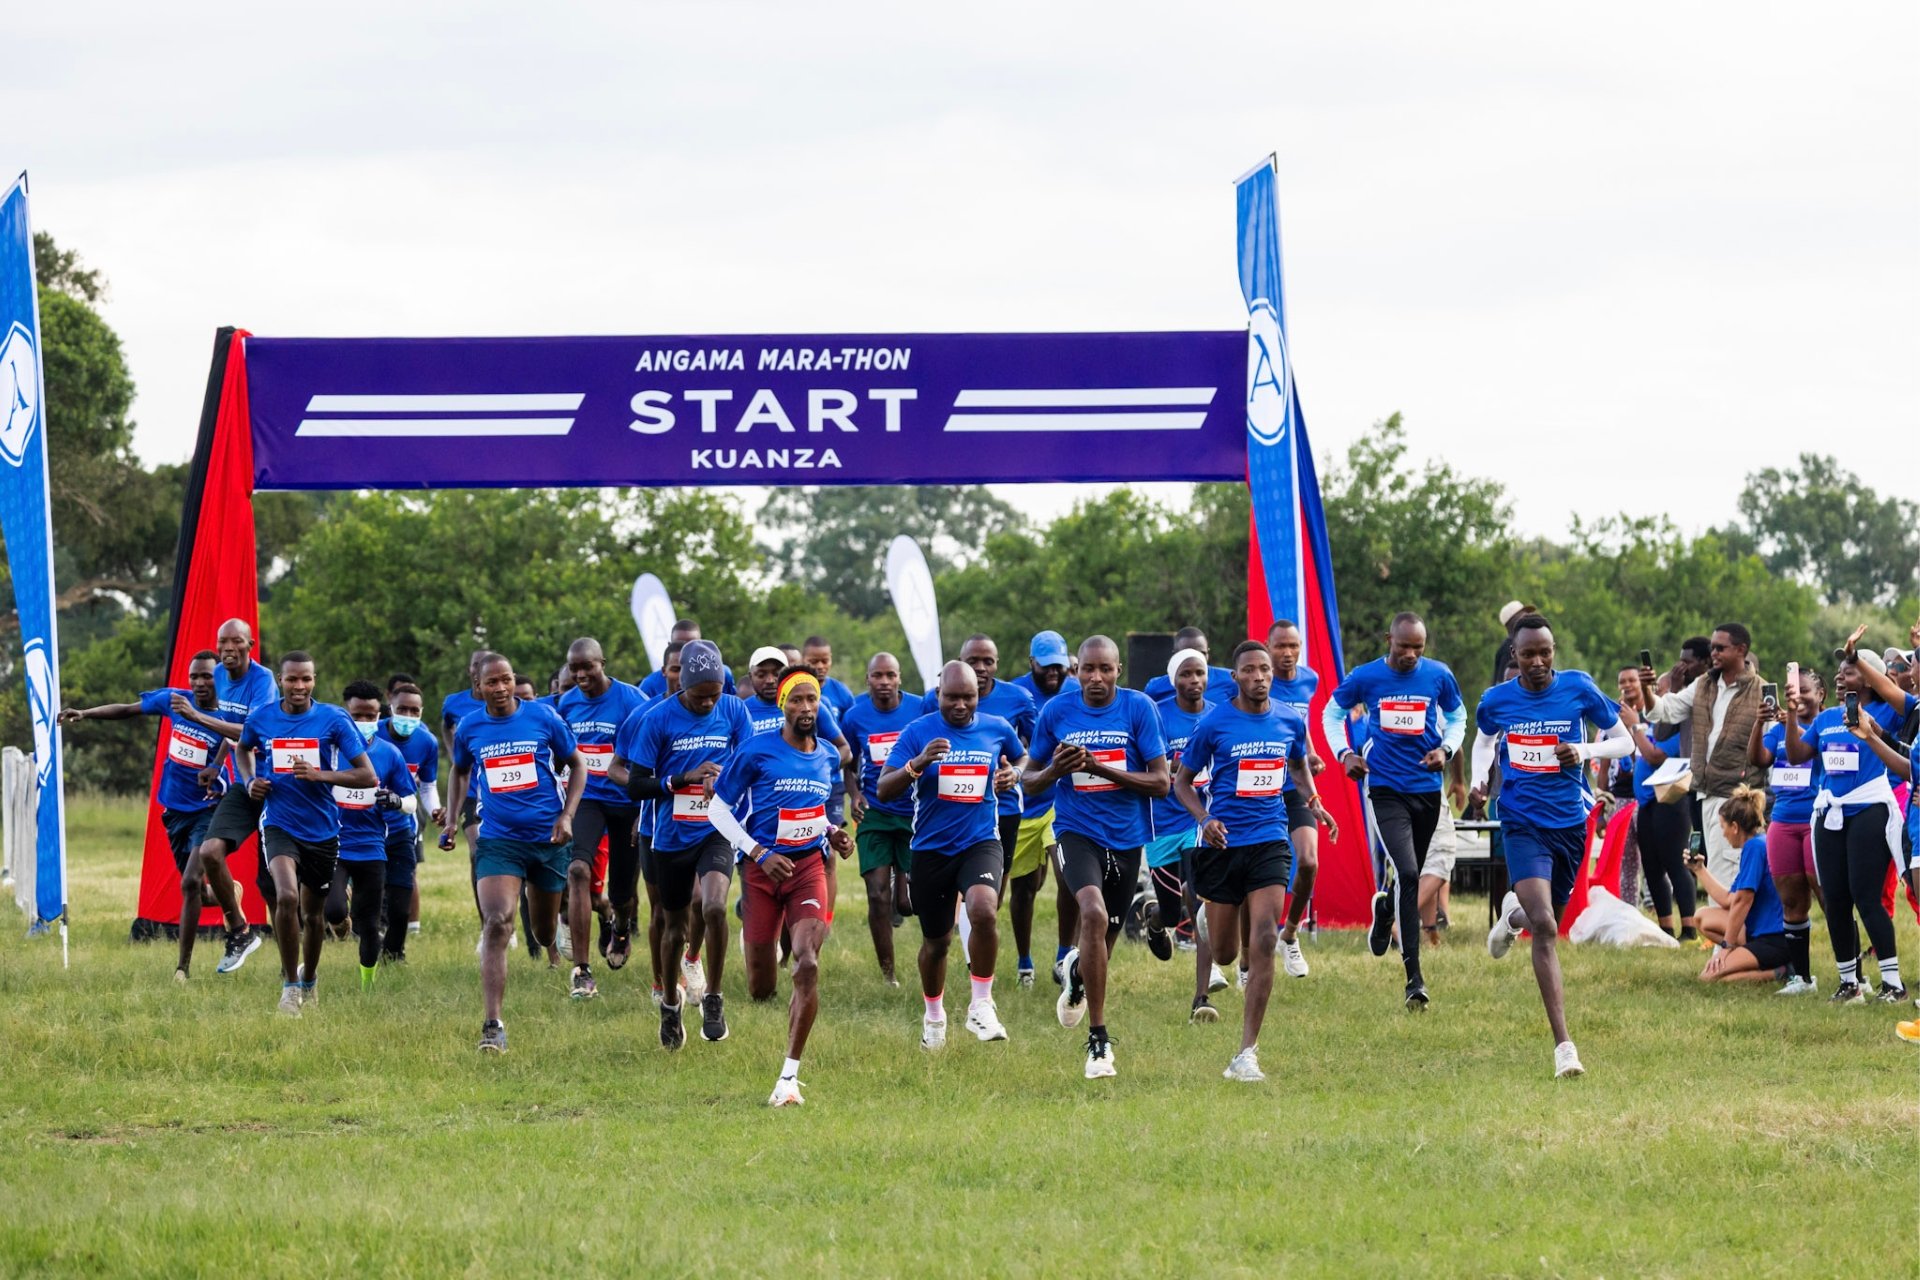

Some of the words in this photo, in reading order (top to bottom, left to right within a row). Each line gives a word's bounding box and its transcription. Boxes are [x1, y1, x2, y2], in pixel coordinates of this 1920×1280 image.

[635, 349, 745, 372] ANGAMA
[757, 348, 911, 371] MARA-THON
[629, 388, 918, 434] START
[691, 448, 842, 469] KUANZA
[1394, 716, 1414, 726] 240
[1509, 721, 1543, 731] ANGAMA
[1065, 730, 1100, 741] ANGAMA
[1518, 726, 1571, 736] MARA-THON
[672, 735, 704, 747] ANGAMA
[680, 740, 728, 751] MARA-THON
[1074, 736, 1129, 745] MARA-THON
[177, 746, 194, 759] 253
[480, 741, 511, 754] ANGAMA
[487, 745, 538, 758] MARA-THON
[1231, 741, 1265, 753] ANGAMA
[1240, 746, 1287, 757] MARA-THON
[941, 754, 992, 764] MARA-THON
[1522, 750, 1542, 762] 221
[1828, 756, 1845, 766] 008
[585, 757, 602, 768] 223
[501, 770, 522, 783] 239
[1253, 775, 1273, 787] 232
[1783, 772, 1799, 782] 004
[775, 778, 809, 787] ANGAMA
[953, 783, 974, 794] 229
[346, 789, 365, 801] 243
[690, 800, 710, 811] 244
[793, 825, 813, 839] 228
